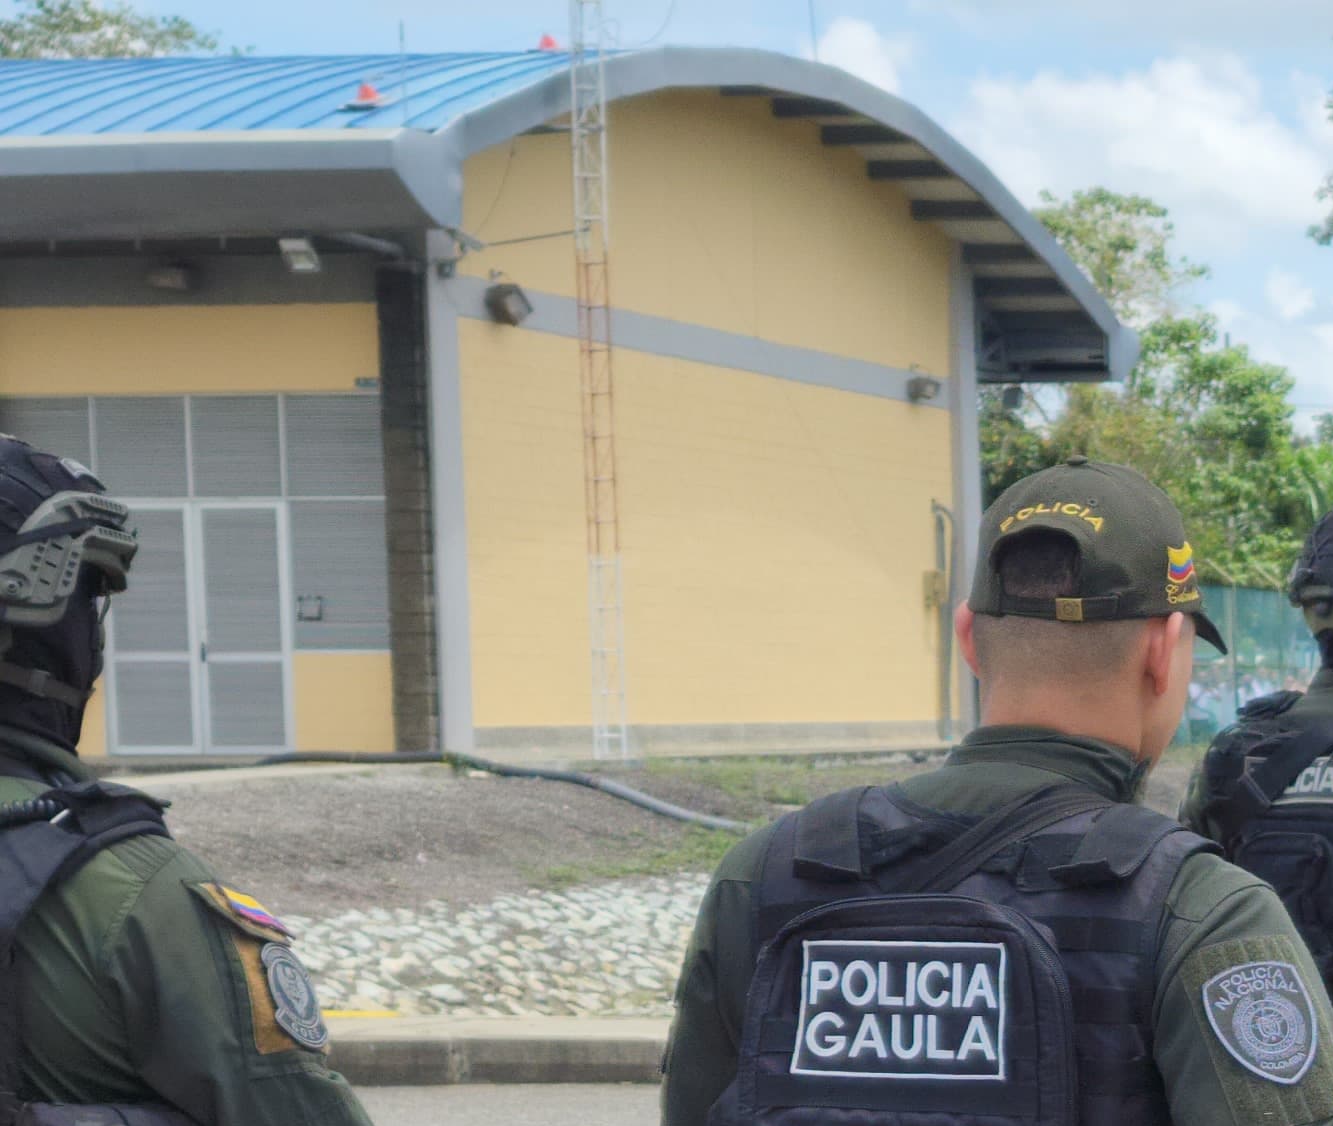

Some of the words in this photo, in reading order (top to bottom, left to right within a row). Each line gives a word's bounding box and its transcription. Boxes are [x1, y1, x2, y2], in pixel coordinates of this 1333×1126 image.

[999, 501, 1105, 532] POLICIA
[808, 959, 998, 1008] POLICIA
[1214, 978, 1299, 1011] NACIONAL
[805, 1011, 997, 1060] GAULA
